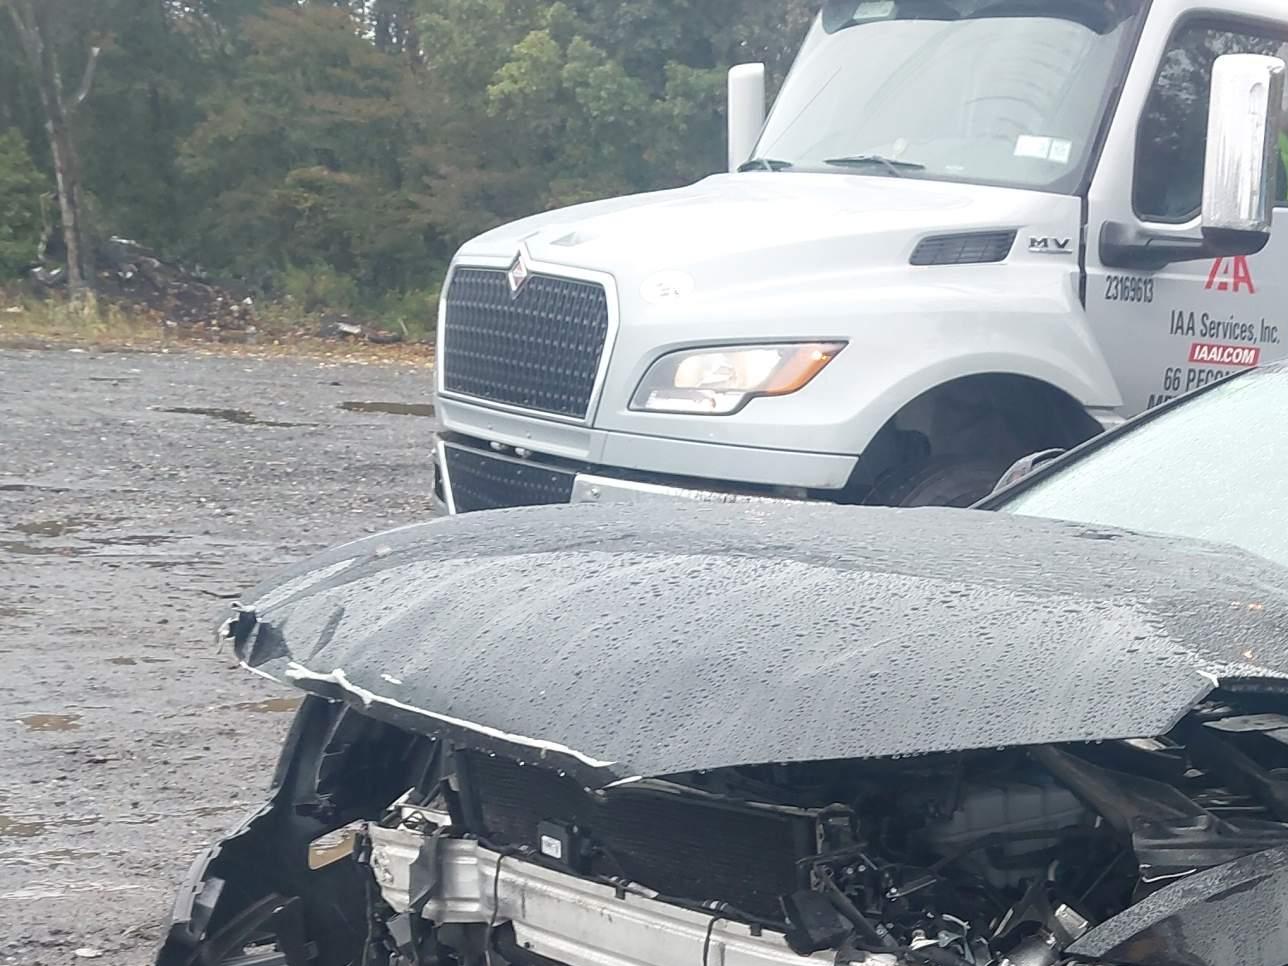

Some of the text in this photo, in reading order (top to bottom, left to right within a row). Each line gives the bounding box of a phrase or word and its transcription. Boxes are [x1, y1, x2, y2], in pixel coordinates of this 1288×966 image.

[1105, 275, 1154, 303] 23169613
[1170, 310, 1280, 344] IAA Services, Inc.
[1193, 344, 1256, 364] IAAI.COM
[1164, 367, 1182, 391] 66
